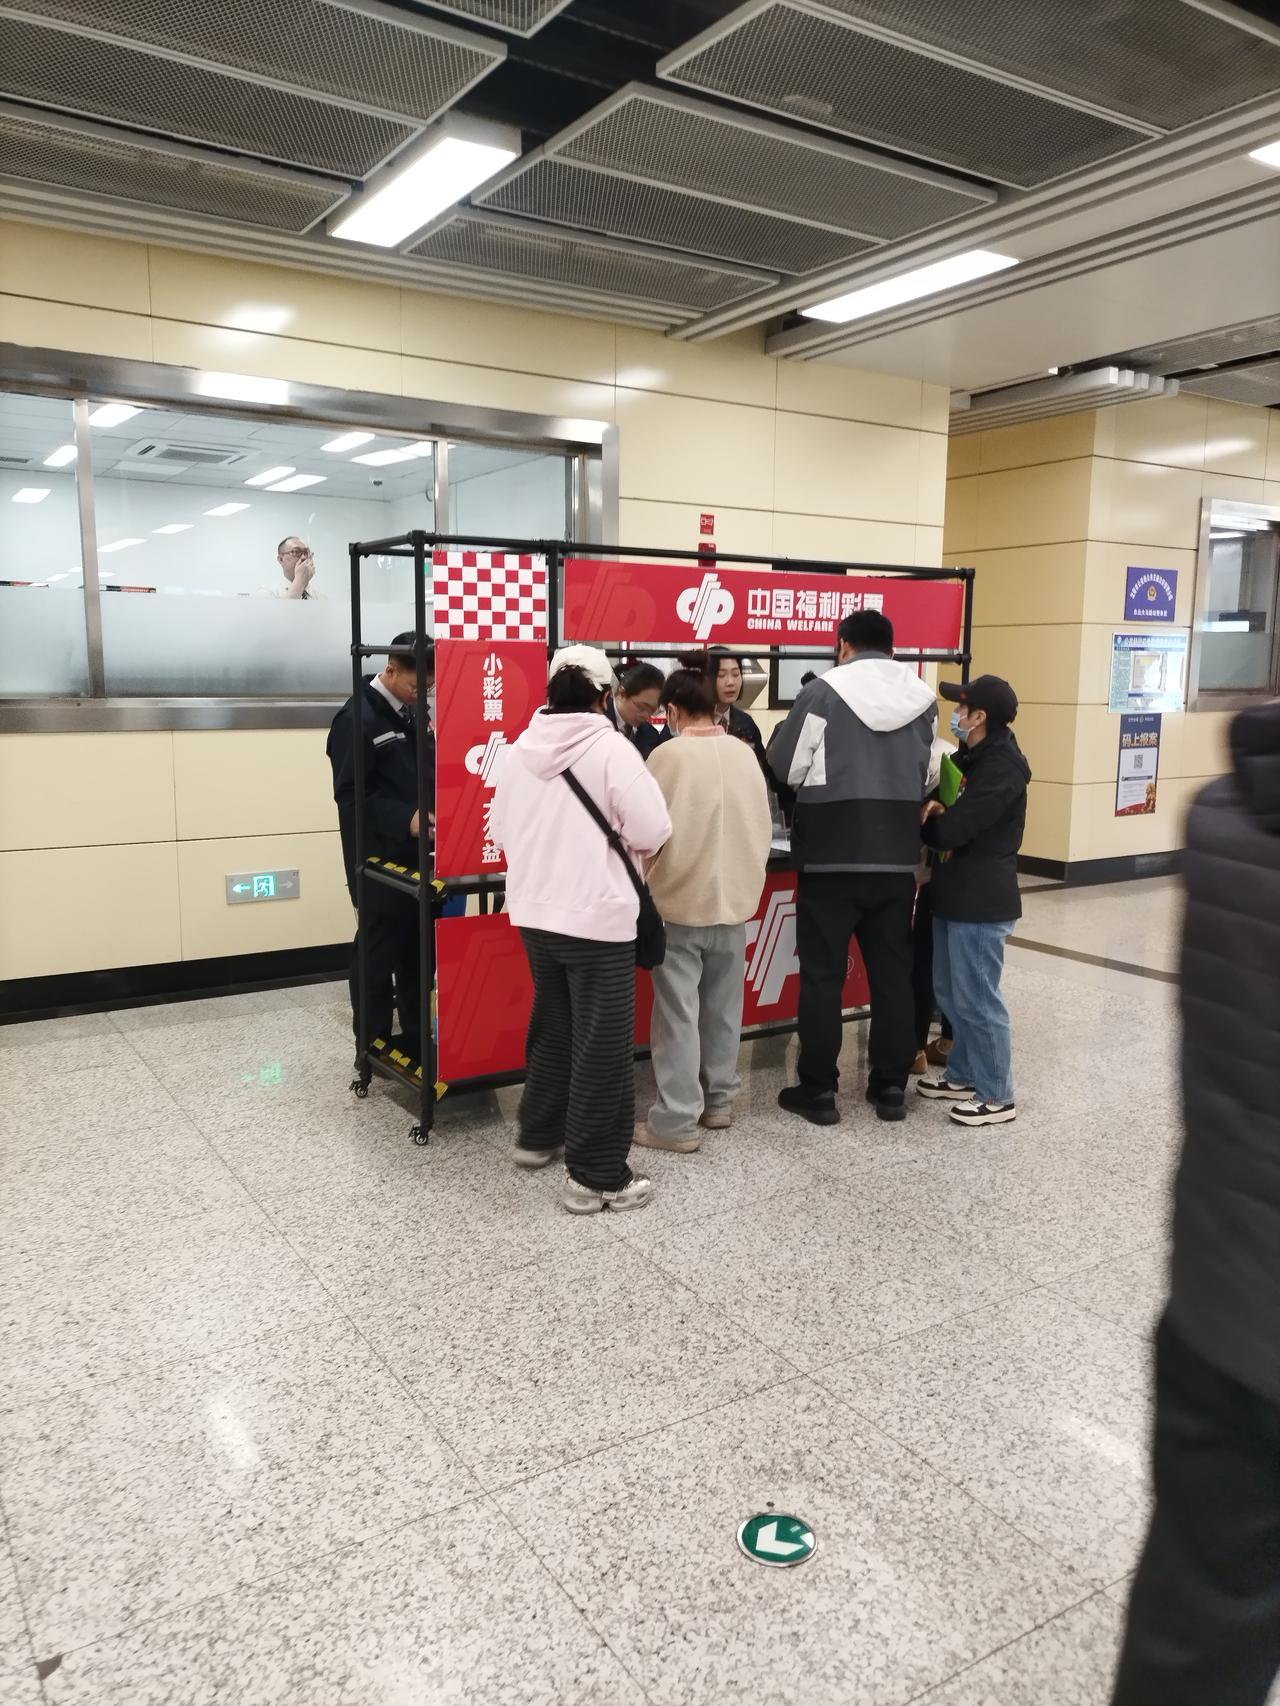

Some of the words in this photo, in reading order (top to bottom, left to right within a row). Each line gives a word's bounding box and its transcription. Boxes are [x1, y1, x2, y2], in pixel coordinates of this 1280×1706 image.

[748, 588, 883, 620] 中国福利彩票
[747, 618, 782, 630] CHINA
[787, 620, 834, 632] WELFARE
[483, 653, 503, 721] 小彩票
[1122, 731, 1158, 747] 码上报案
